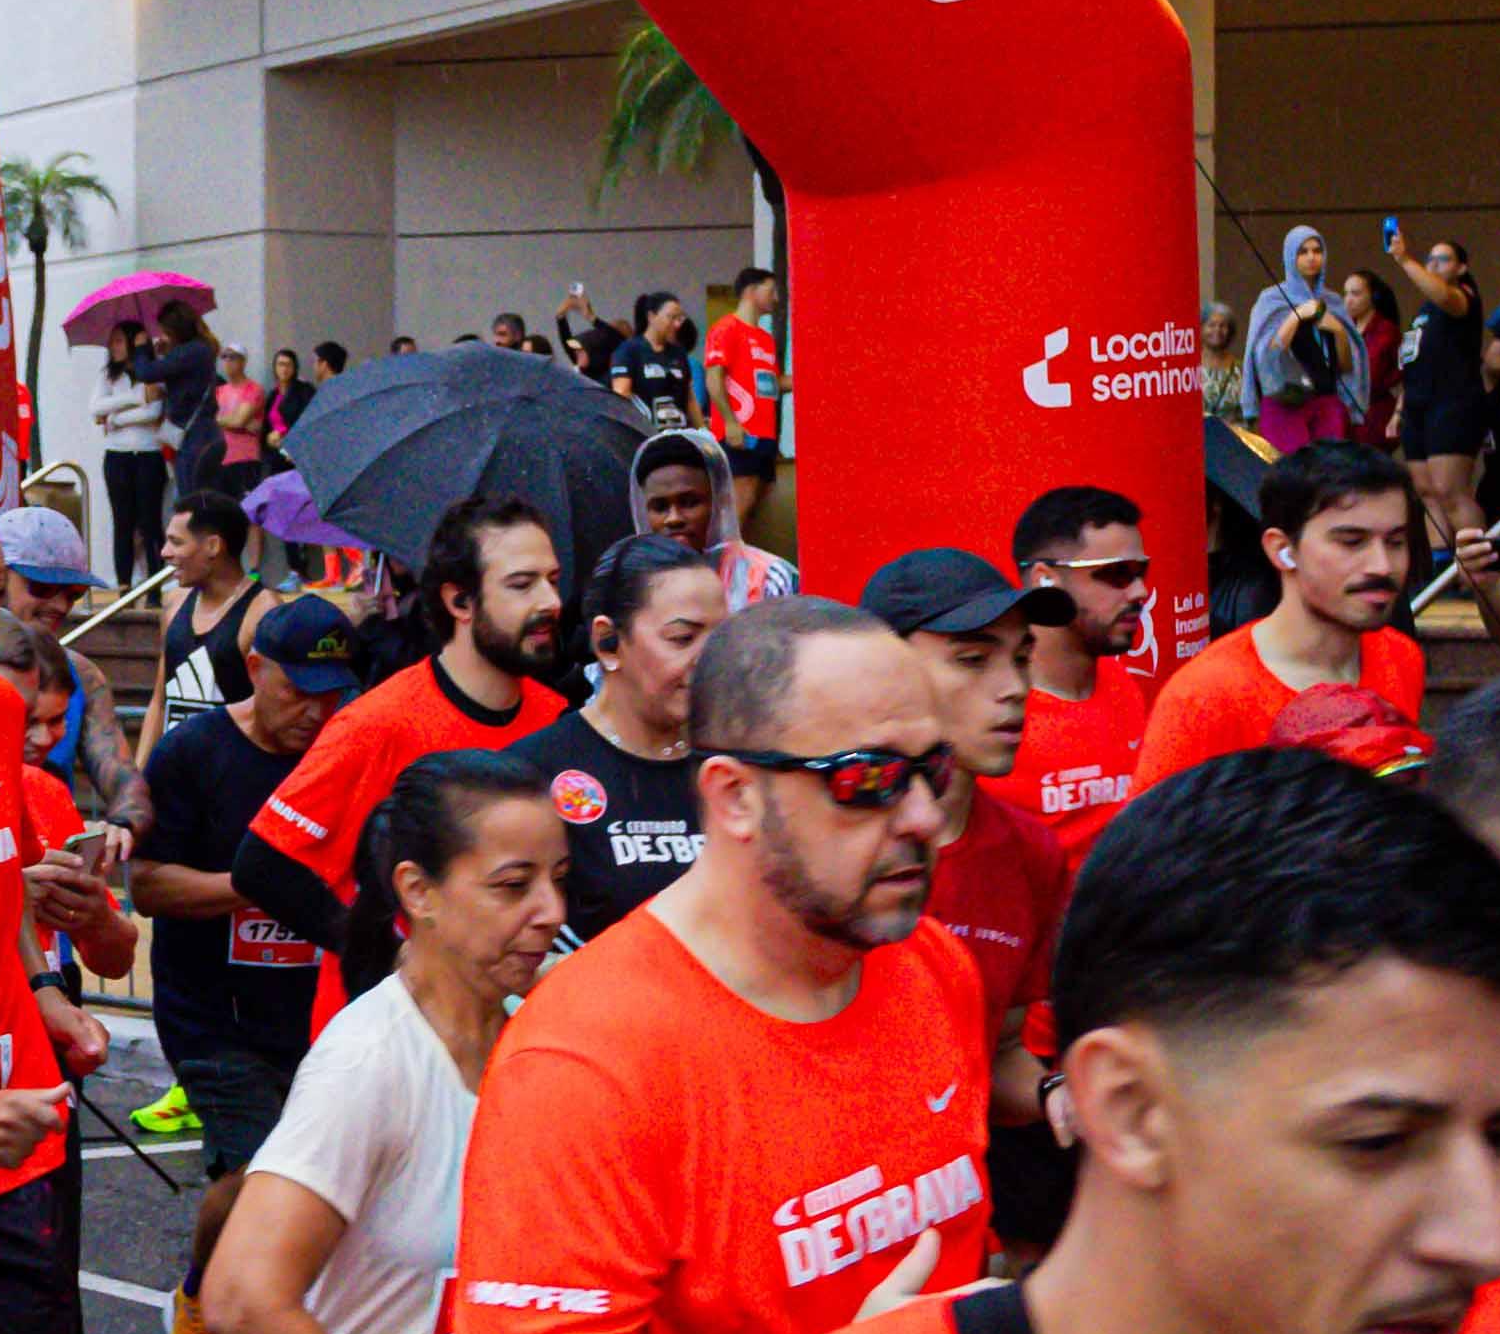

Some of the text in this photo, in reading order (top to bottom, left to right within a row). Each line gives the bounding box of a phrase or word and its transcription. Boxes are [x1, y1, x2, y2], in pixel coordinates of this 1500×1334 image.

[1090, 322, 1195, 363] Localiza
[1092, 361, 1201, 402] seminov
[610, 834, 707, 866] DESB
[778, 1153, 984, 1288] DESBRAVA
